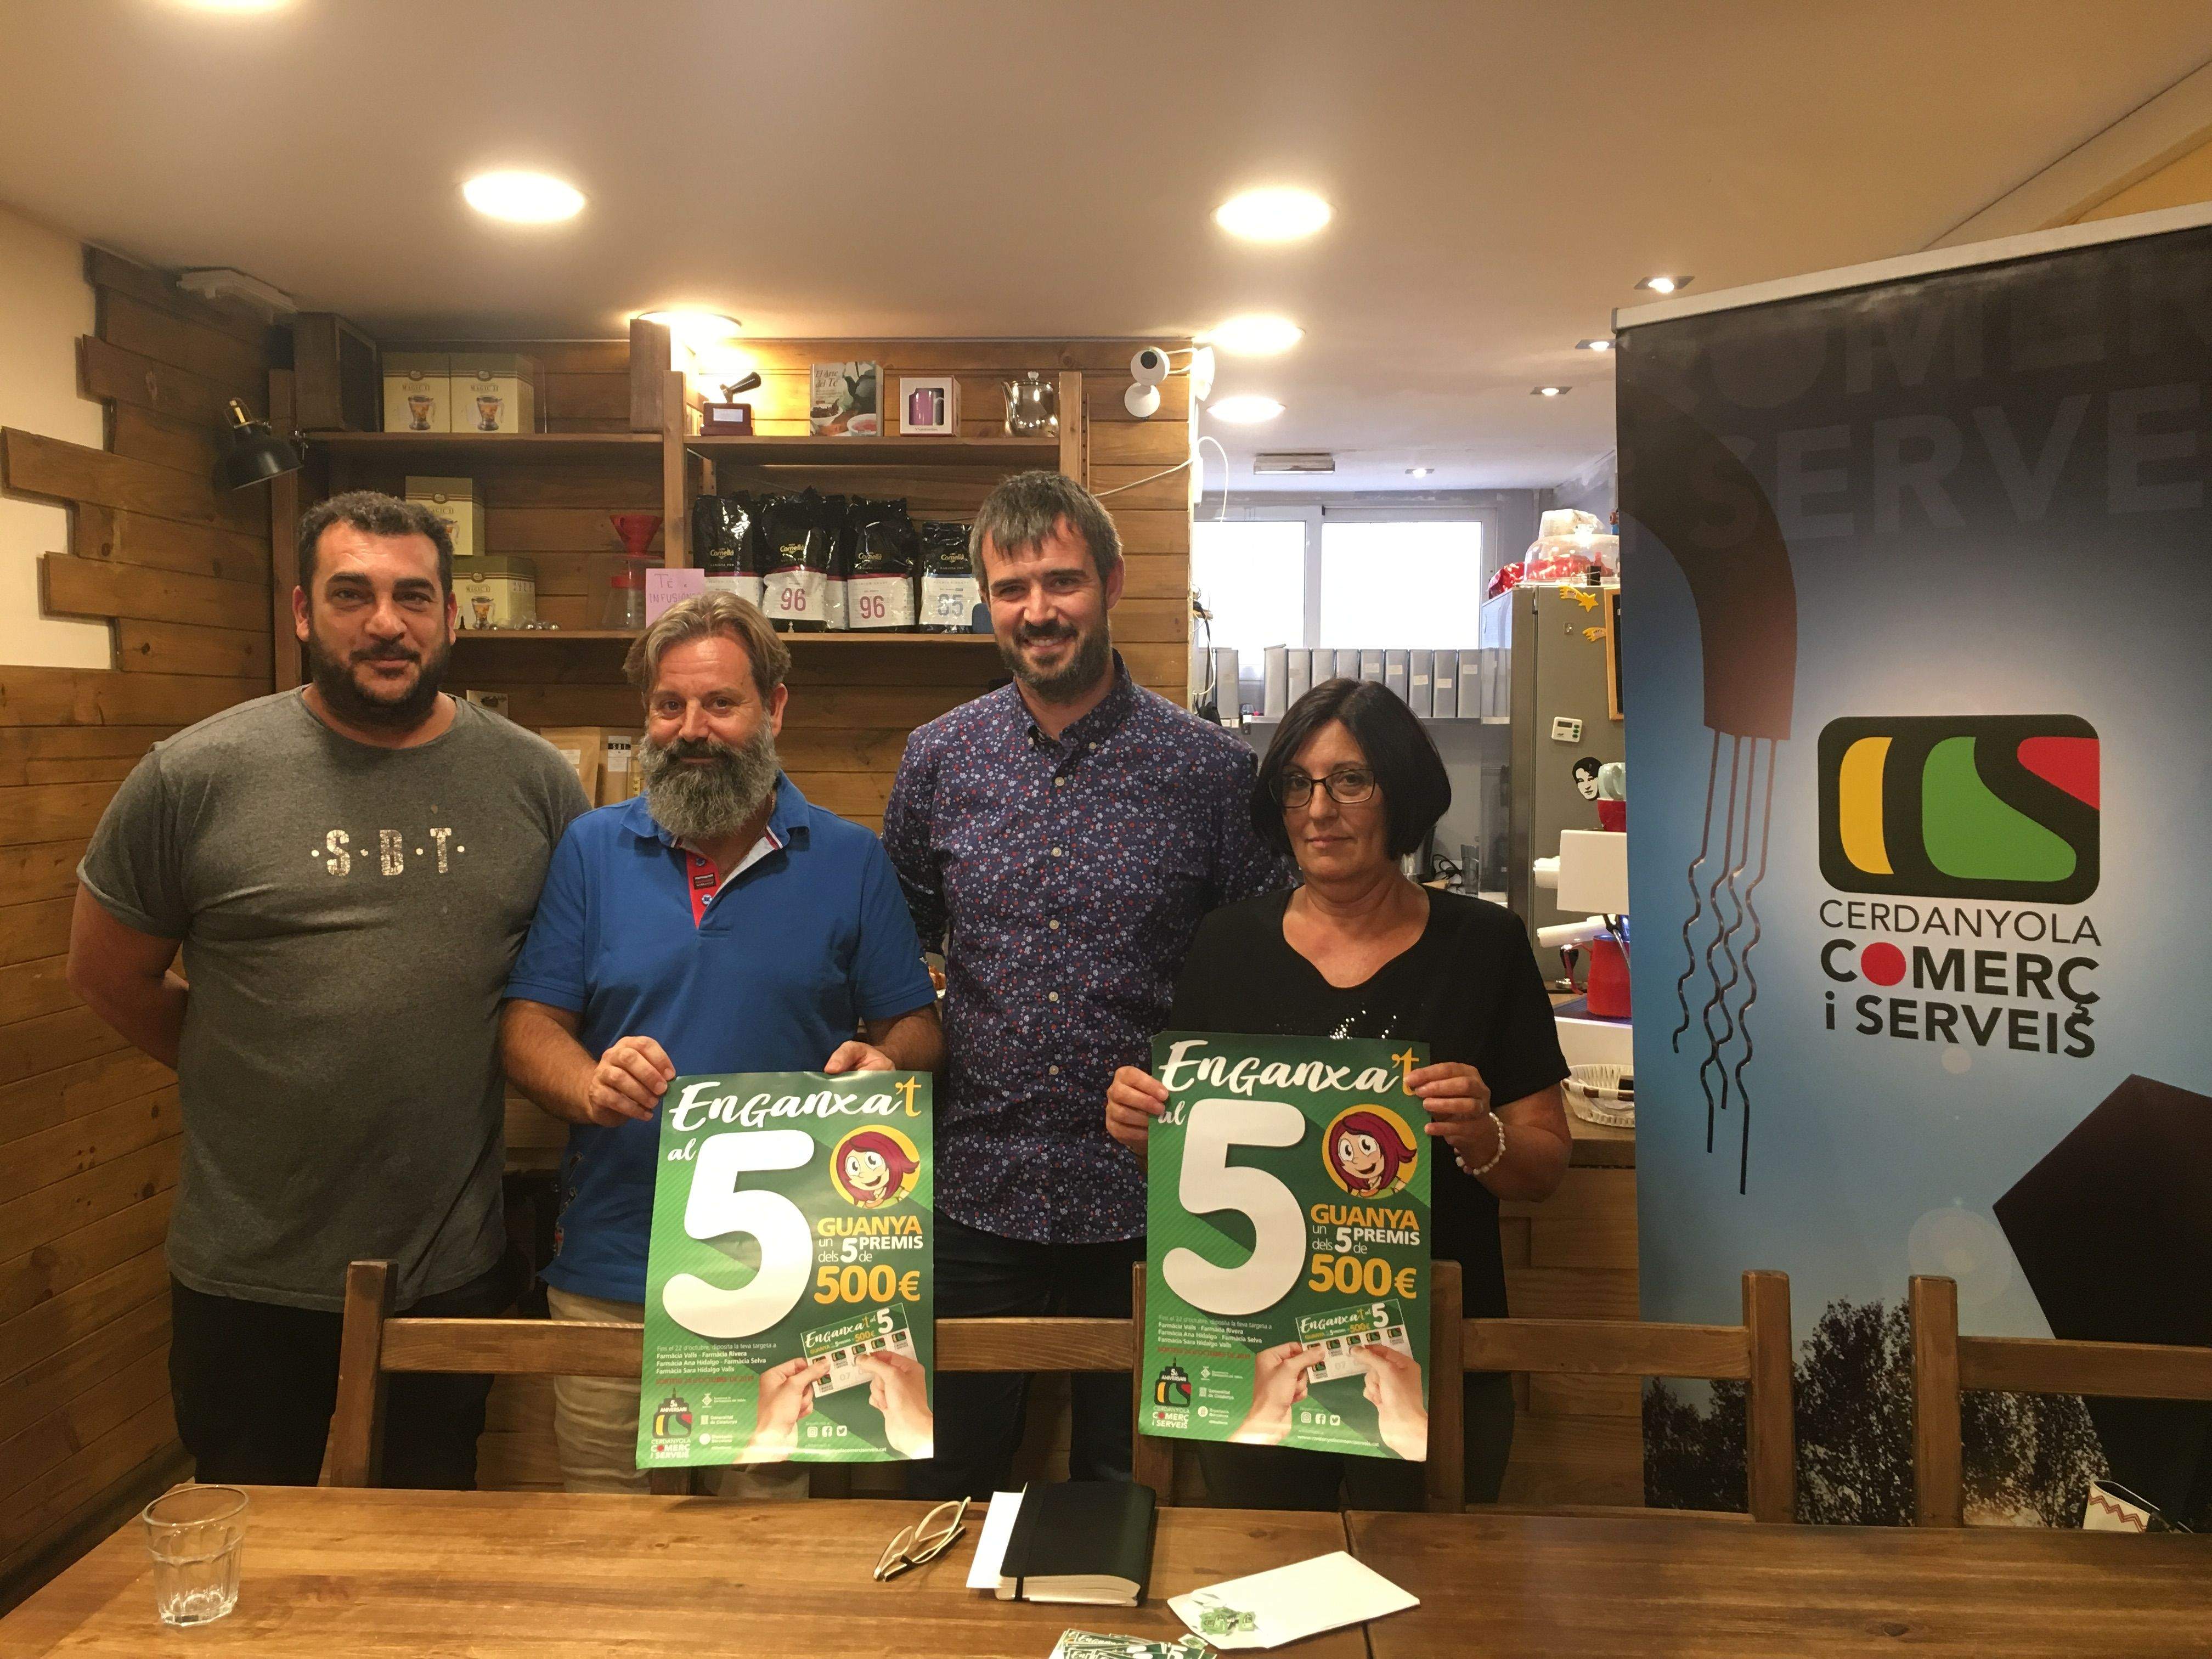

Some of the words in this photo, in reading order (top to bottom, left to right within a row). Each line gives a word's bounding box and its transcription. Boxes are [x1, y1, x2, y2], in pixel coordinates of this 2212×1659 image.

[780, 588, 806, 611] 96
[860, 595, 885, 619] 96
[1820, 899, 2102, 946] CERDANYOLA
[1855, 995, 2096, 1058] SERVEIS
[667, 1138, 697, 1161] al
[1163, 1098, 1307, 1316] 5
[1311, 1204, 1420, 1231] GUANYA
[662, 1129, 815, 1339] 5
[817, 1215, 923, 1237] GUANYA
[1312, 1224, 1327, 1234] un
[1334, 1227, 1352, 1254] 5
[1353, 1227, 1420, 1245] PREMIS
[818, 1250, 839, 1262] dels
[859, 1250, 873, 1262] de
[819, 1238, 833, 1247] un
[840, 1237, 858, 1263] 5
[859, 1235, 923, 1250] PREMIS
[1312, 1239, 1333, 1251] dels
[1353, 1242, 1368, 1255] de
[814, 1264, 921, 1304] 500€
[1308, 1253, 1417, 1300] 500€
[877, 1308, 894, 1334] 5
[1372, 1302, 1389, 1328] 5
[697, 1359, 719, 1367] Hidalgo
[839, 1372, 851, 1381] 07
[1156, 1420, 1188, 1429] SERVEIS
